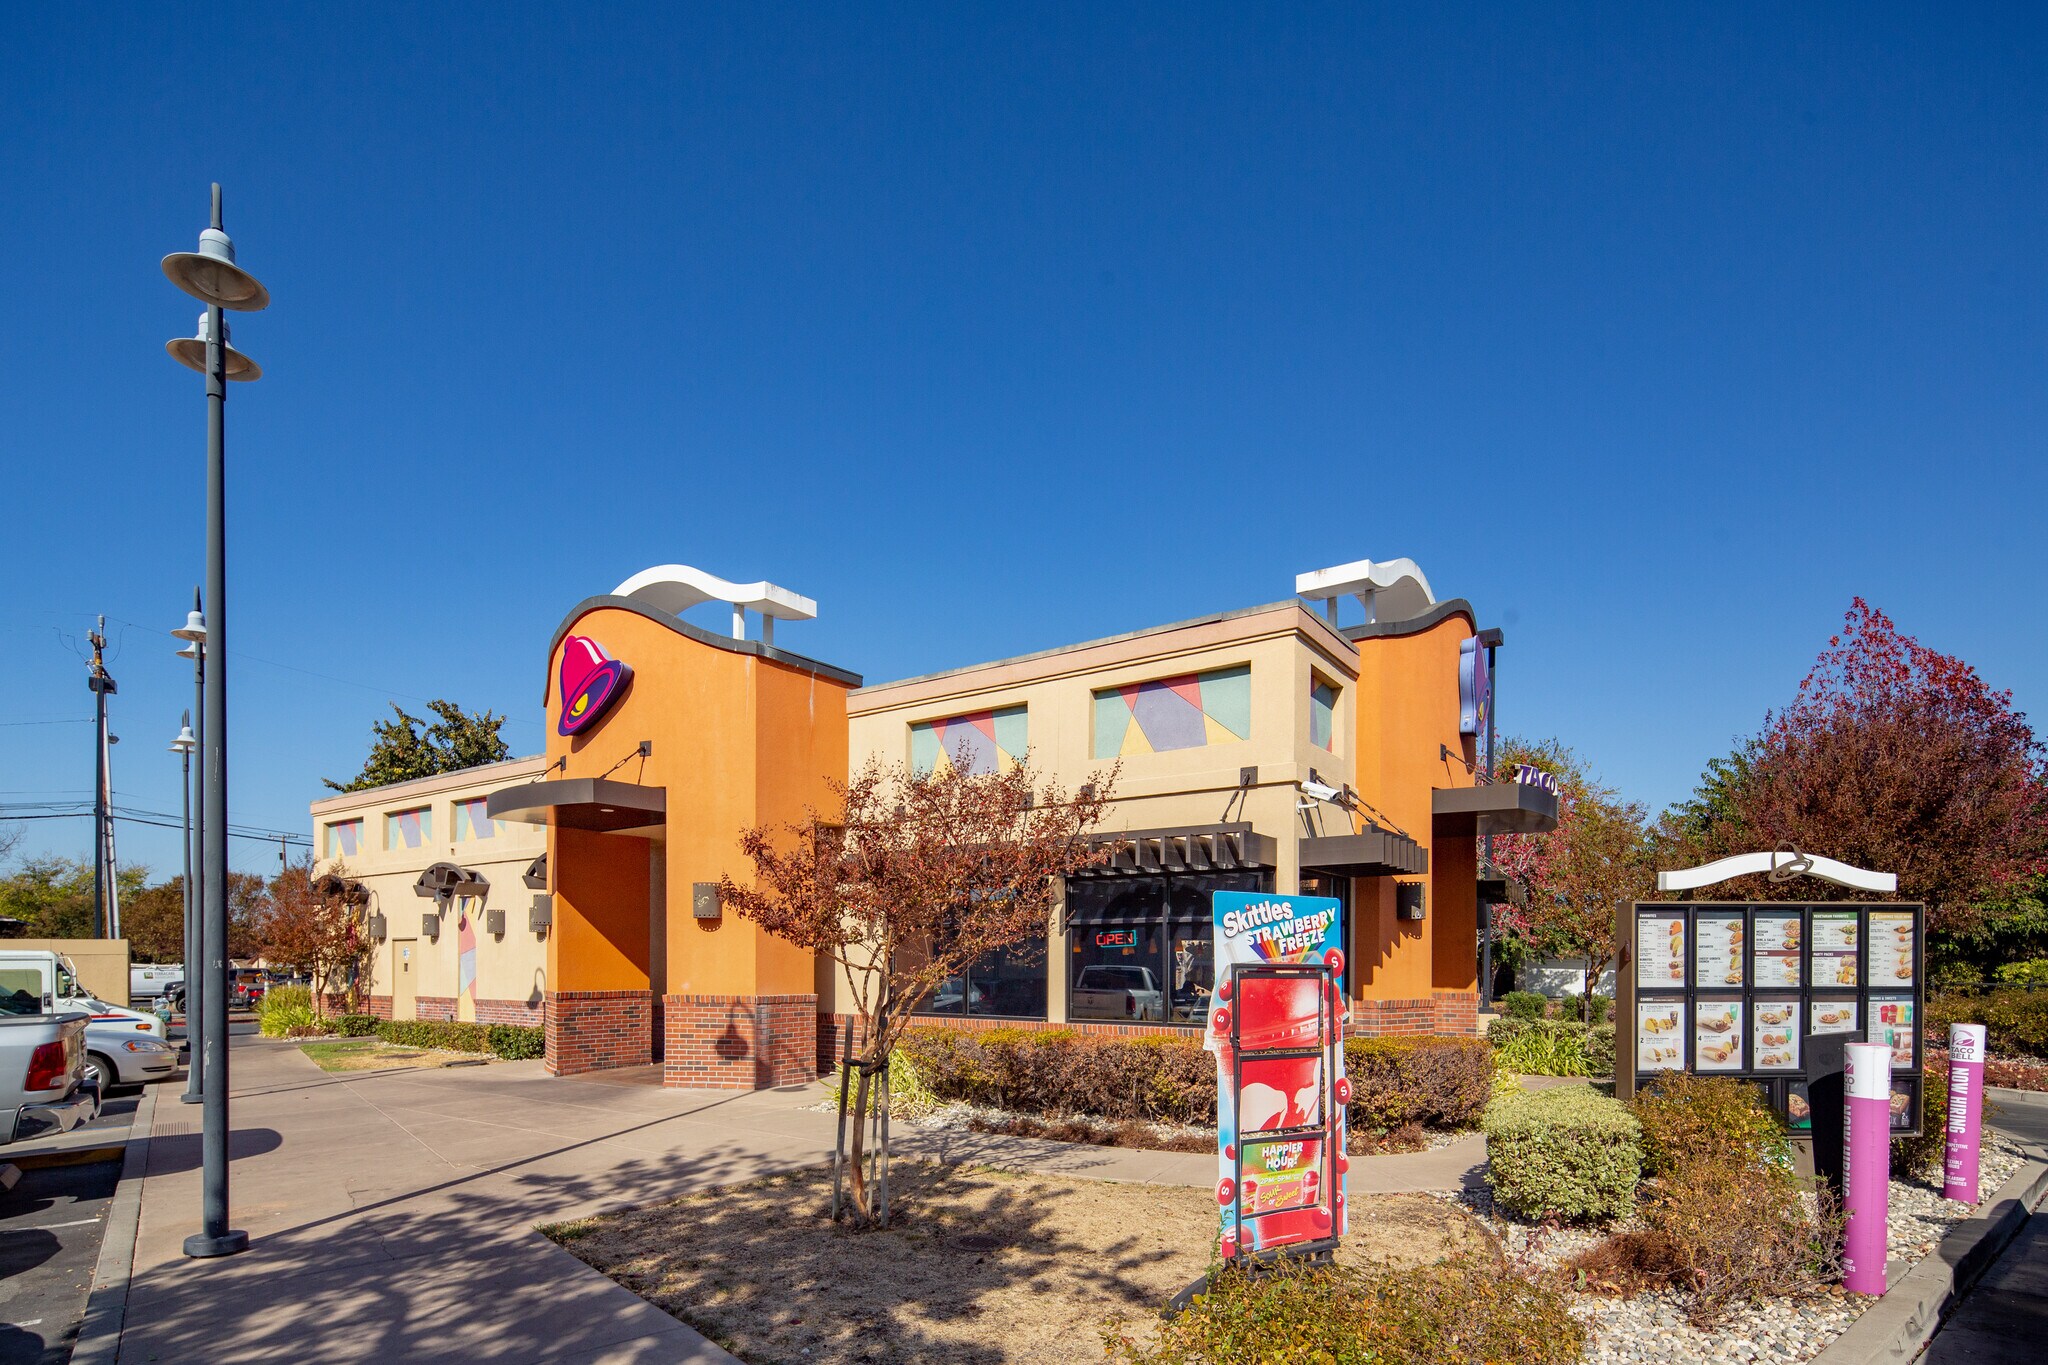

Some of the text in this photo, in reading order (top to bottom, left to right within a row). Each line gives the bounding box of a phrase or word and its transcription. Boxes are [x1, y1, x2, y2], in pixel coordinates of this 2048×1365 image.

[1516, 764, 1556, 795] TACO
[1223, 900, 1294, 938] Skittles
[1246, 907, 1336, 946] STRAWBERRY
[1096, 932, 1133, 945] OPEN
[1279, 928, 1326, 954] FREEZE
[1331, 956, 1338, 968] S
[1217, 1014, 1224, 1023] S
[1340, 1086, 1347, 1096] S
[1949, 1067, 1970, 1134] NOW HIRING
[1262, 1142, 1303, 1157] HAPPIER
[1266, 1154, 1298, 1168] HOUR!
[1221, 1186, 1230, 1196] S
[1275, 1186, 1299, 1207] Sweet
